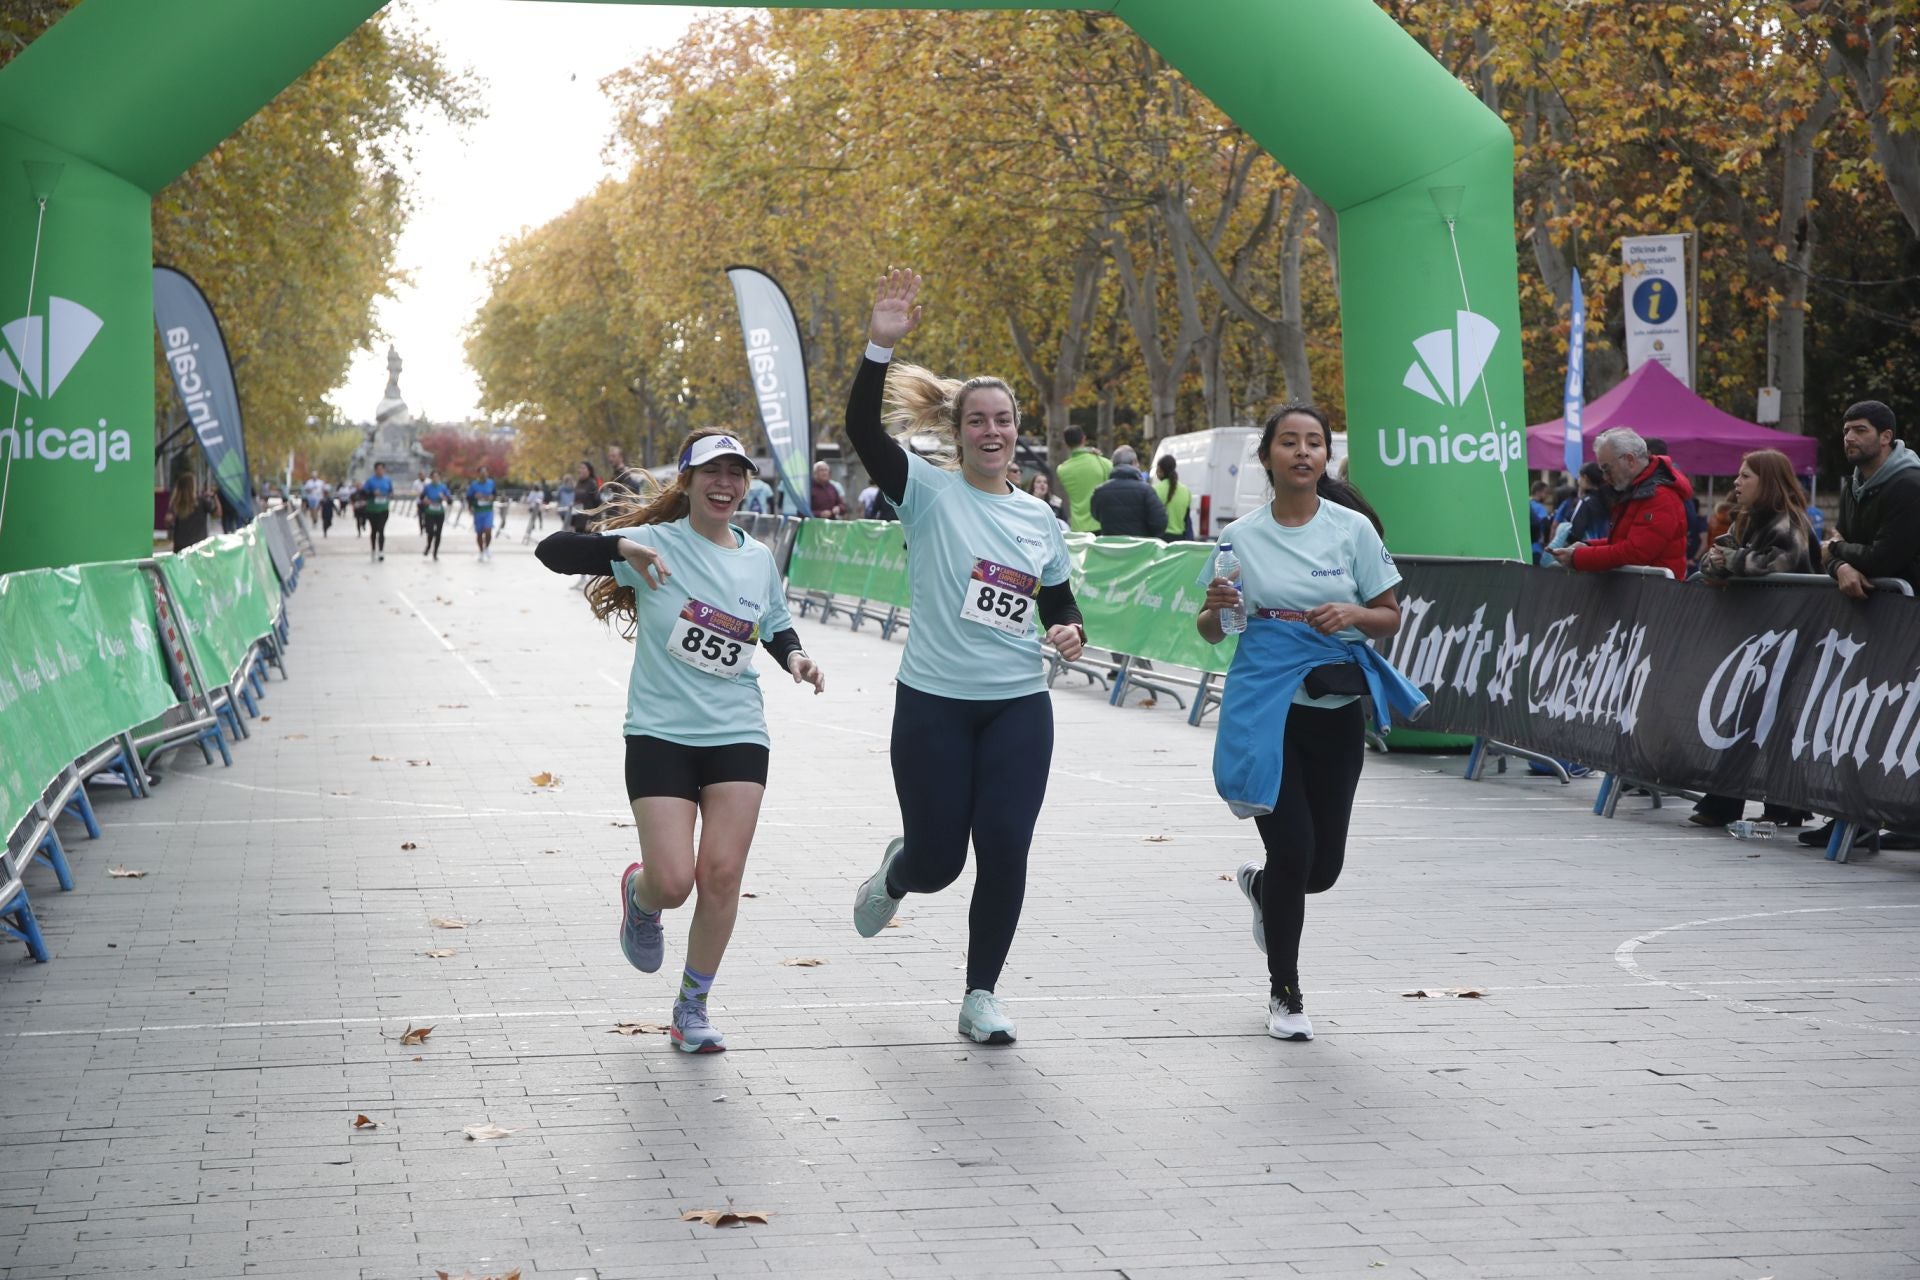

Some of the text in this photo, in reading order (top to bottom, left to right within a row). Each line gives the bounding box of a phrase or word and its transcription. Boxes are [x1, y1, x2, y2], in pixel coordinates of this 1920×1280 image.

[1657, 244, 1667, 252] de
[0, 417, 131, 472] nicaja
[1378, 421, 1522, 472] Unicaja
[976, 586, 1028, 624] 852
[682, 626, 742, 667] 853
